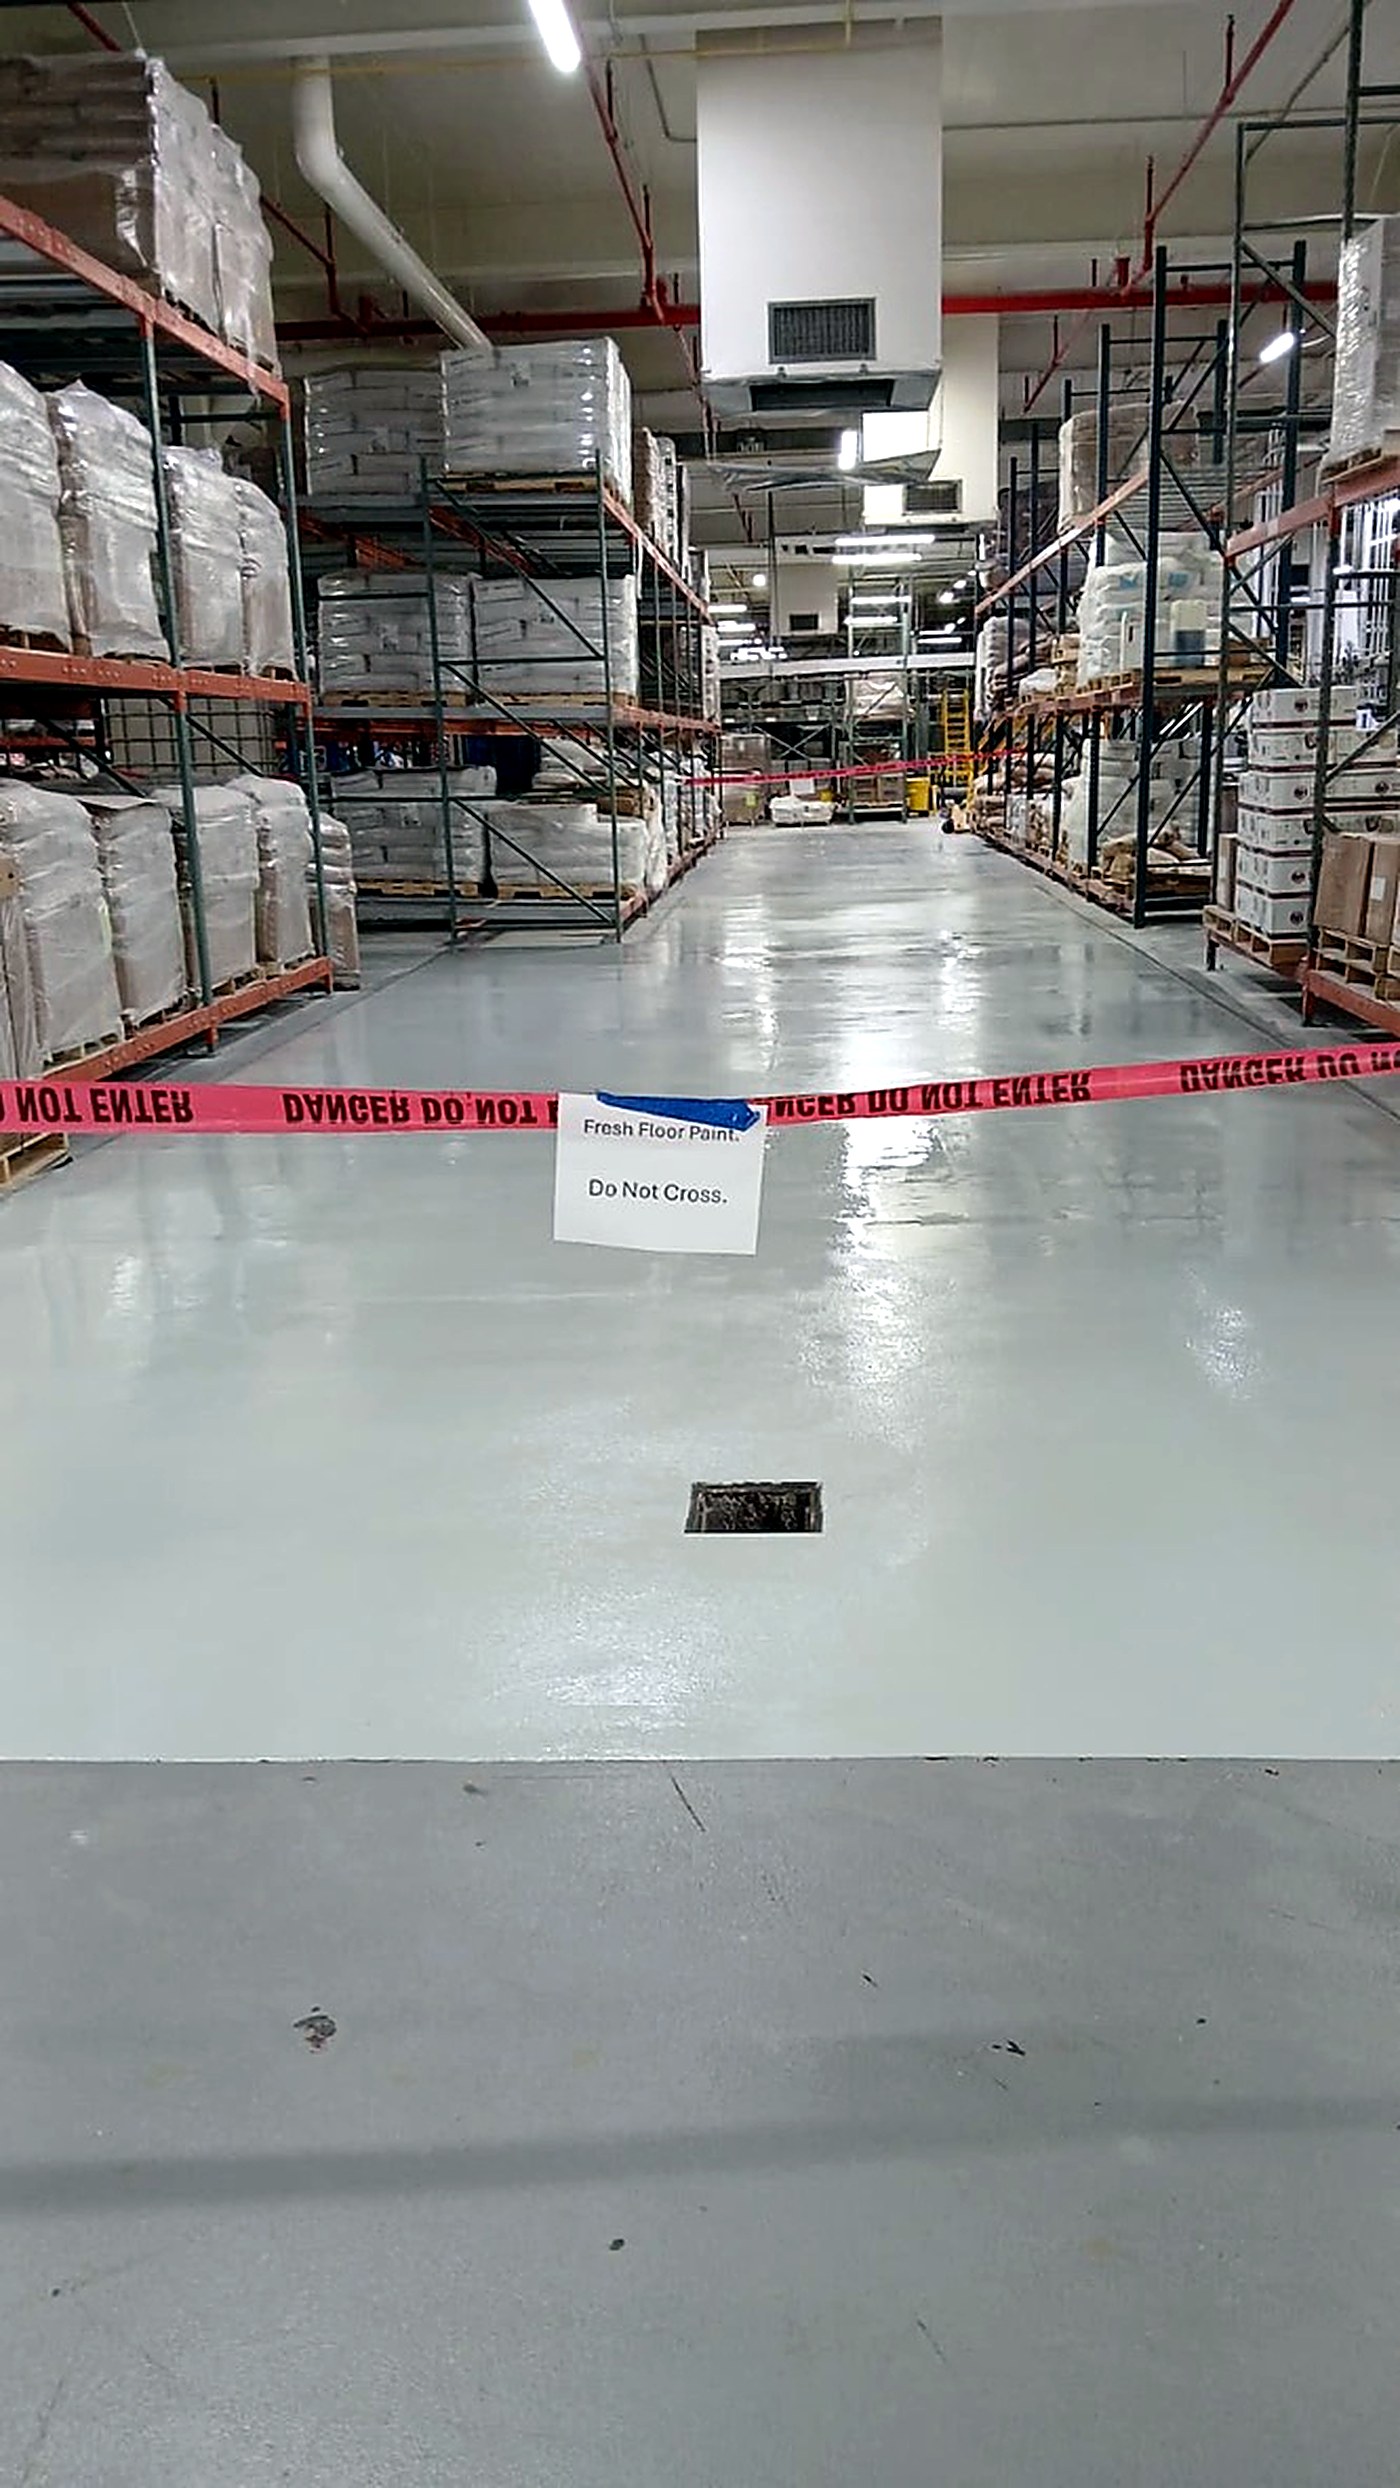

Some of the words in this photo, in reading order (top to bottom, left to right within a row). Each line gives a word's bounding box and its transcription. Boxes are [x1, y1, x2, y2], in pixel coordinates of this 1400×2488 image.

[584, 1119, 633, 1136] Fresh
[639, 1122, 685, 1139] Floor
[690, 1125, 739, 1142] Paint.
[589, 1178, 617, 1197] Do
[622, 1181, 658, 1200] Not
[664, 1184, 728, 1204] Cross.
